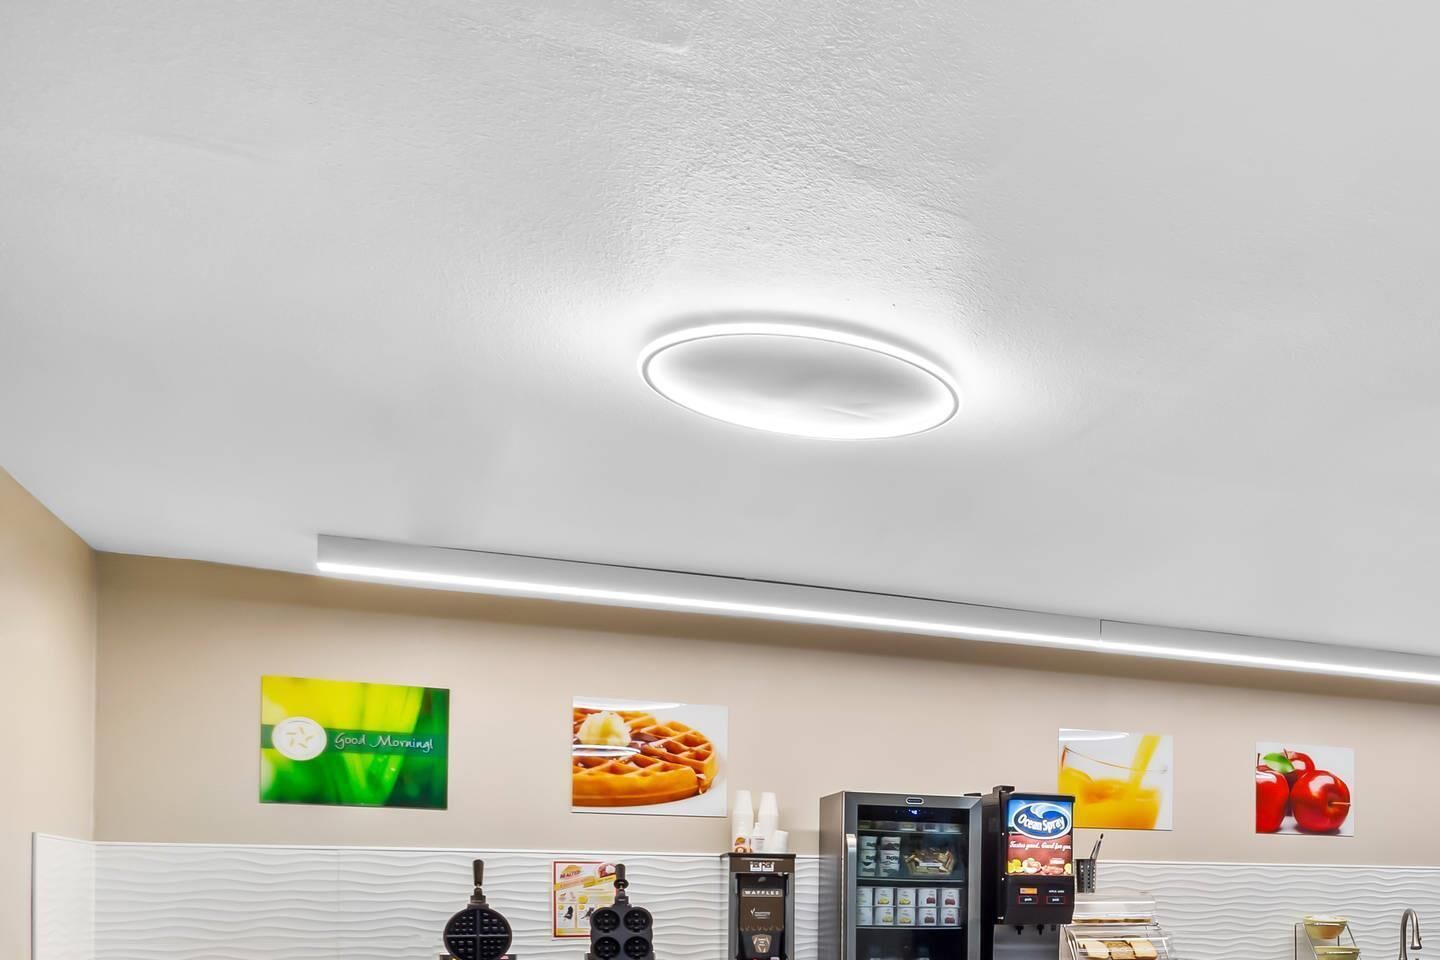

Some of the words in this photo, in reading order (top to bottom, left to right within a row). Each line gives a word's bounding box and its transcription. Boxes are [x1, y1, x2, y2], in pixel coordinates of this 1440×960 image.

[335, 732, 366, 750] Good
[369, 735, 434, 752] Morning!
[1018, 813, 1043, 831] Ocean
[1042, 816, 1066, 834] Spray
